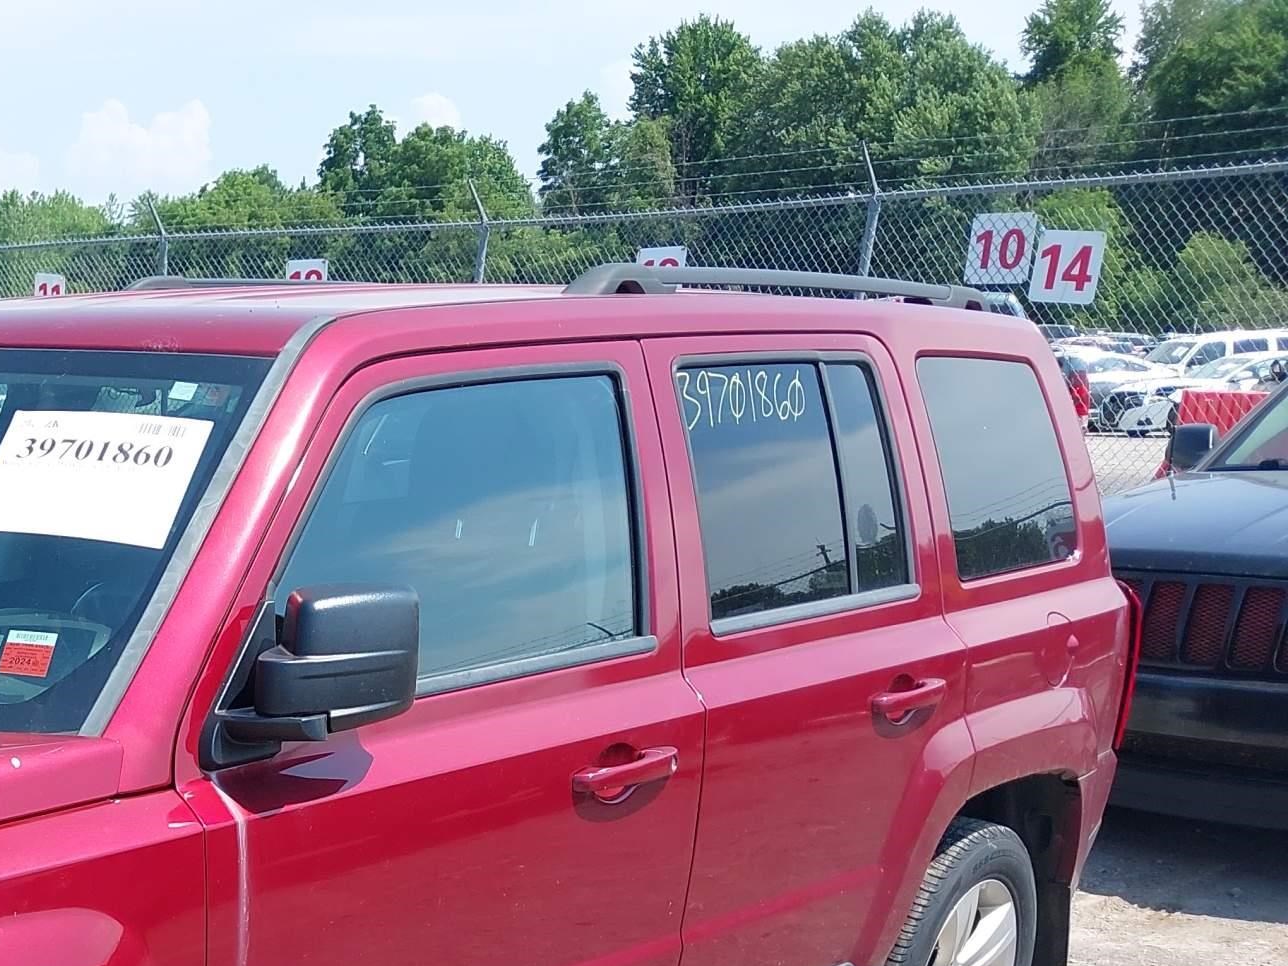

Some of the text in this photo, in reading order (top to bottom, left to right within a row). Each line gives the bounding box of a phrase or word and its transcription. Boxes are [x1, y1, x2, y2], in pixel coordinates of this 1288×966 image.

[975, 228, 1026, 270] 10
[1040, 244, 1093, 291] 14
[676, 369, 805, 431] 39701860
[16, 437, 173, 468] 39701860
[8, 656, 31, 666] 2024
